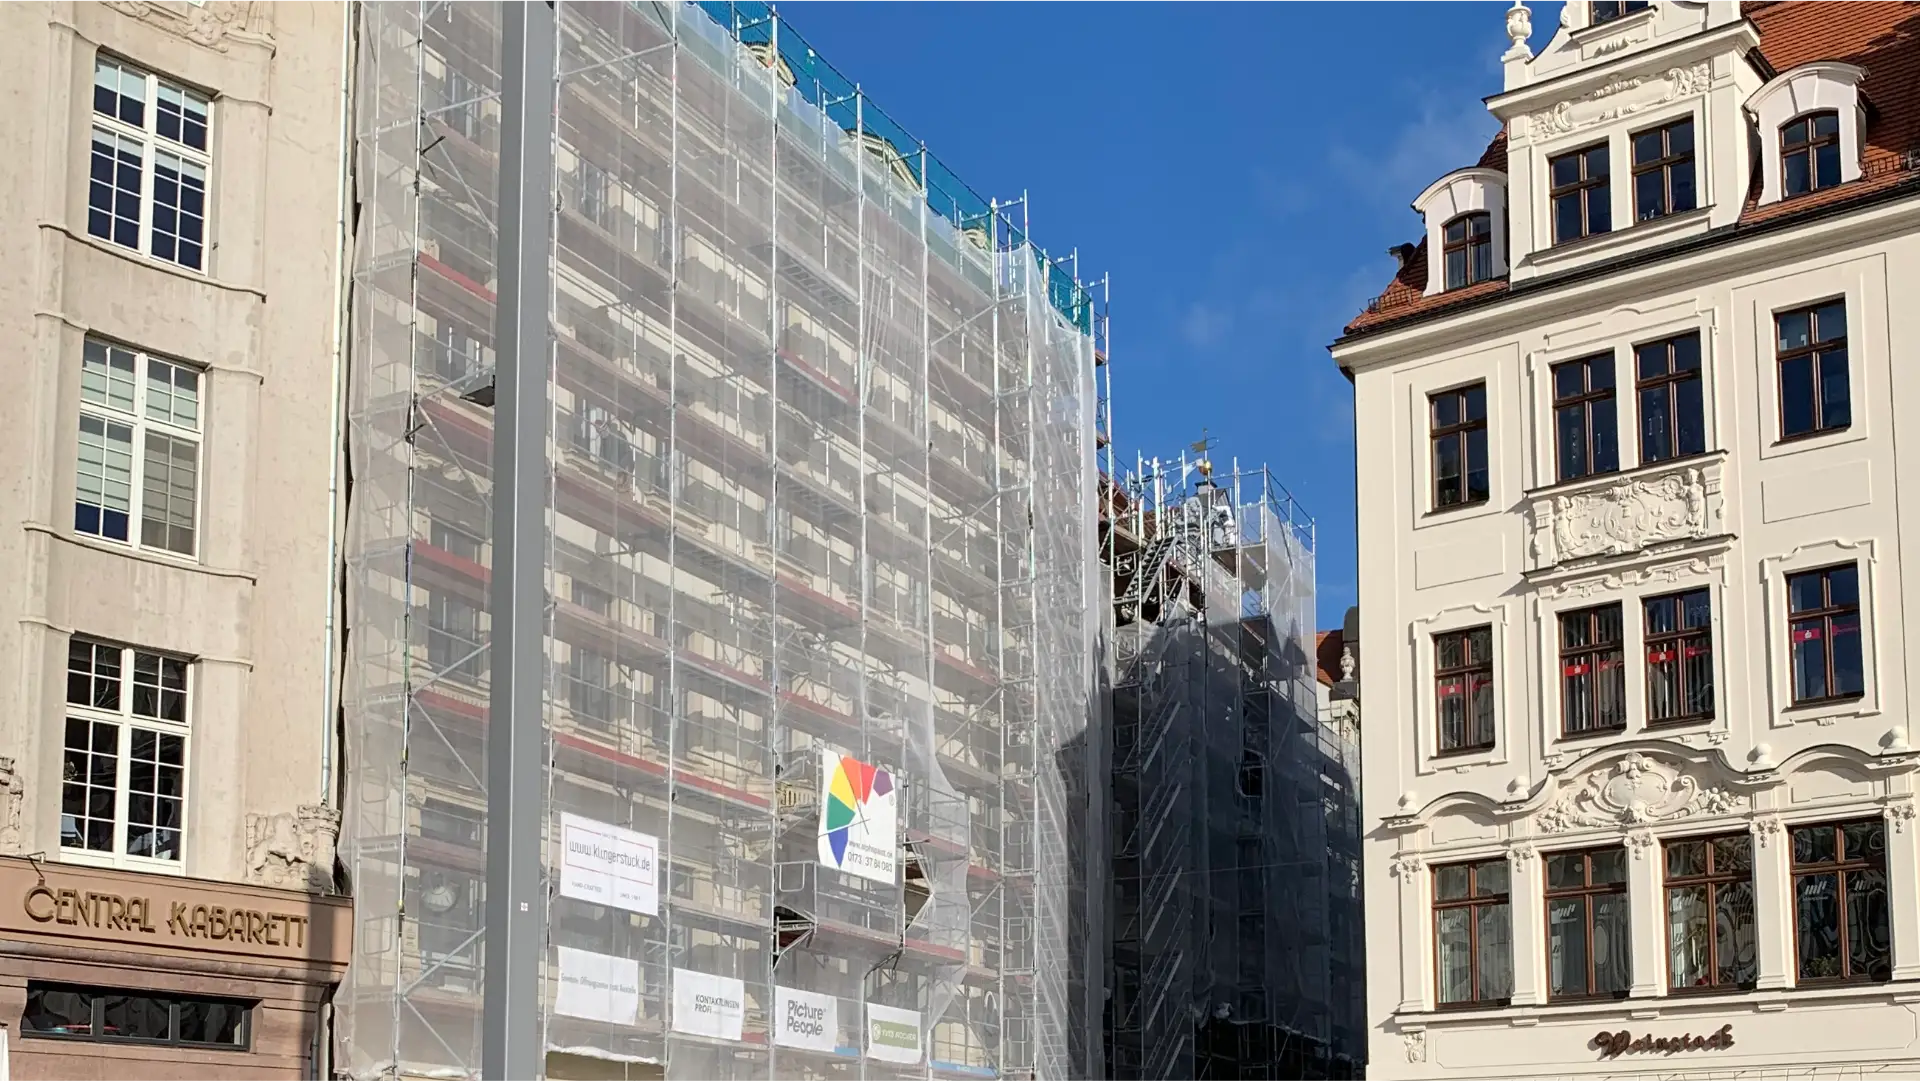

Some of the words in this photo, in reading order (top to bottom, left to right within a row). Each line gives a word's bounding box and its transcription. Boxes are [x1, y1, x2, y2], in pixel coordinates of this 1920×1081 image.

[865, 856, 874, 867] 37
[23, 884, 155, 933] CENTRAL
[168, 901, 308, 948] KABARETT
[694, 1003, 712, 1014] PROFI
[695, 994, 740, 1009] KONTAKTLINSEN
[788, 999, 823, 1020] Picture
[786, 1015, 823, 1038] People
[1592, 1023, 1735, 1057] Weinstock
